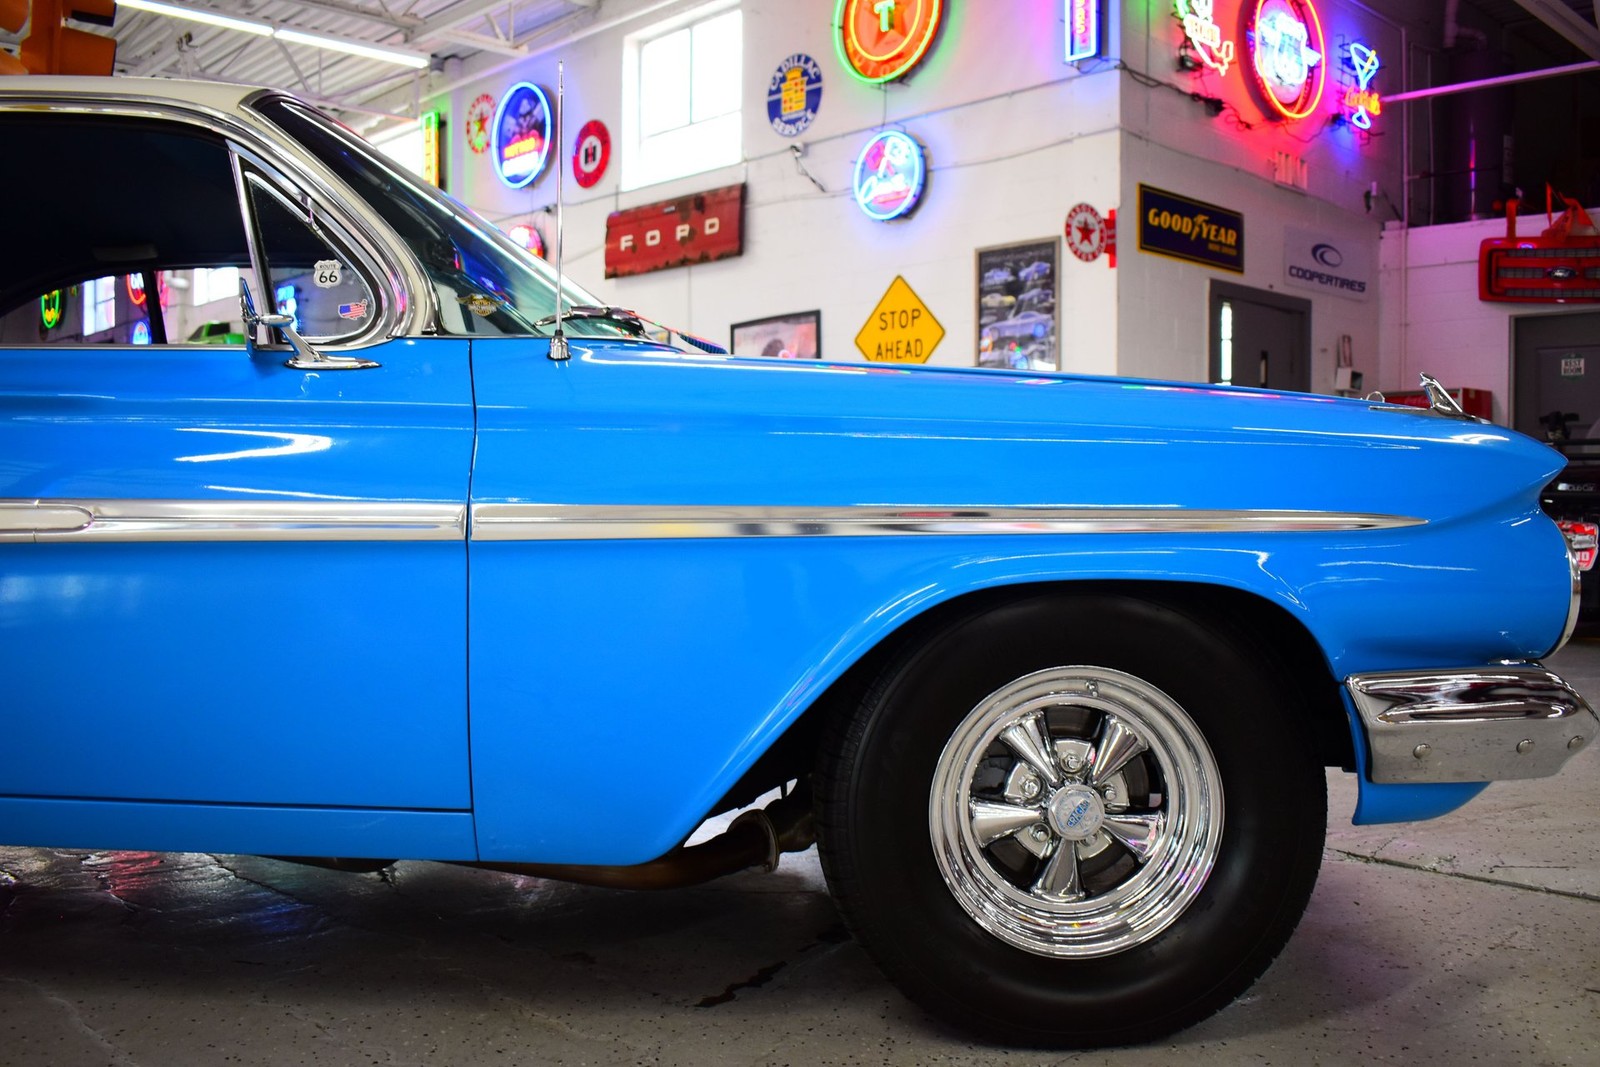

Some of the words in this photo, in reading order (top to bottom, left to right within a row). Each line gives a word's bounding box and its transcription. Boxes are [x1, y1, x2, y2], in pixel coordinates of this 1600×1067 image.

[770, 54, 820, 91] CADILLAC
[773, 108, 815, 135] SERVICE
[620, 217, 720, 251] FORD
[1148, 208, 1237, 246] GOODYEAR
[319, 271, 338, 283] 66
[880, 308, 921, 331] STOP
[876, 338, 923, 361] AHEAD
